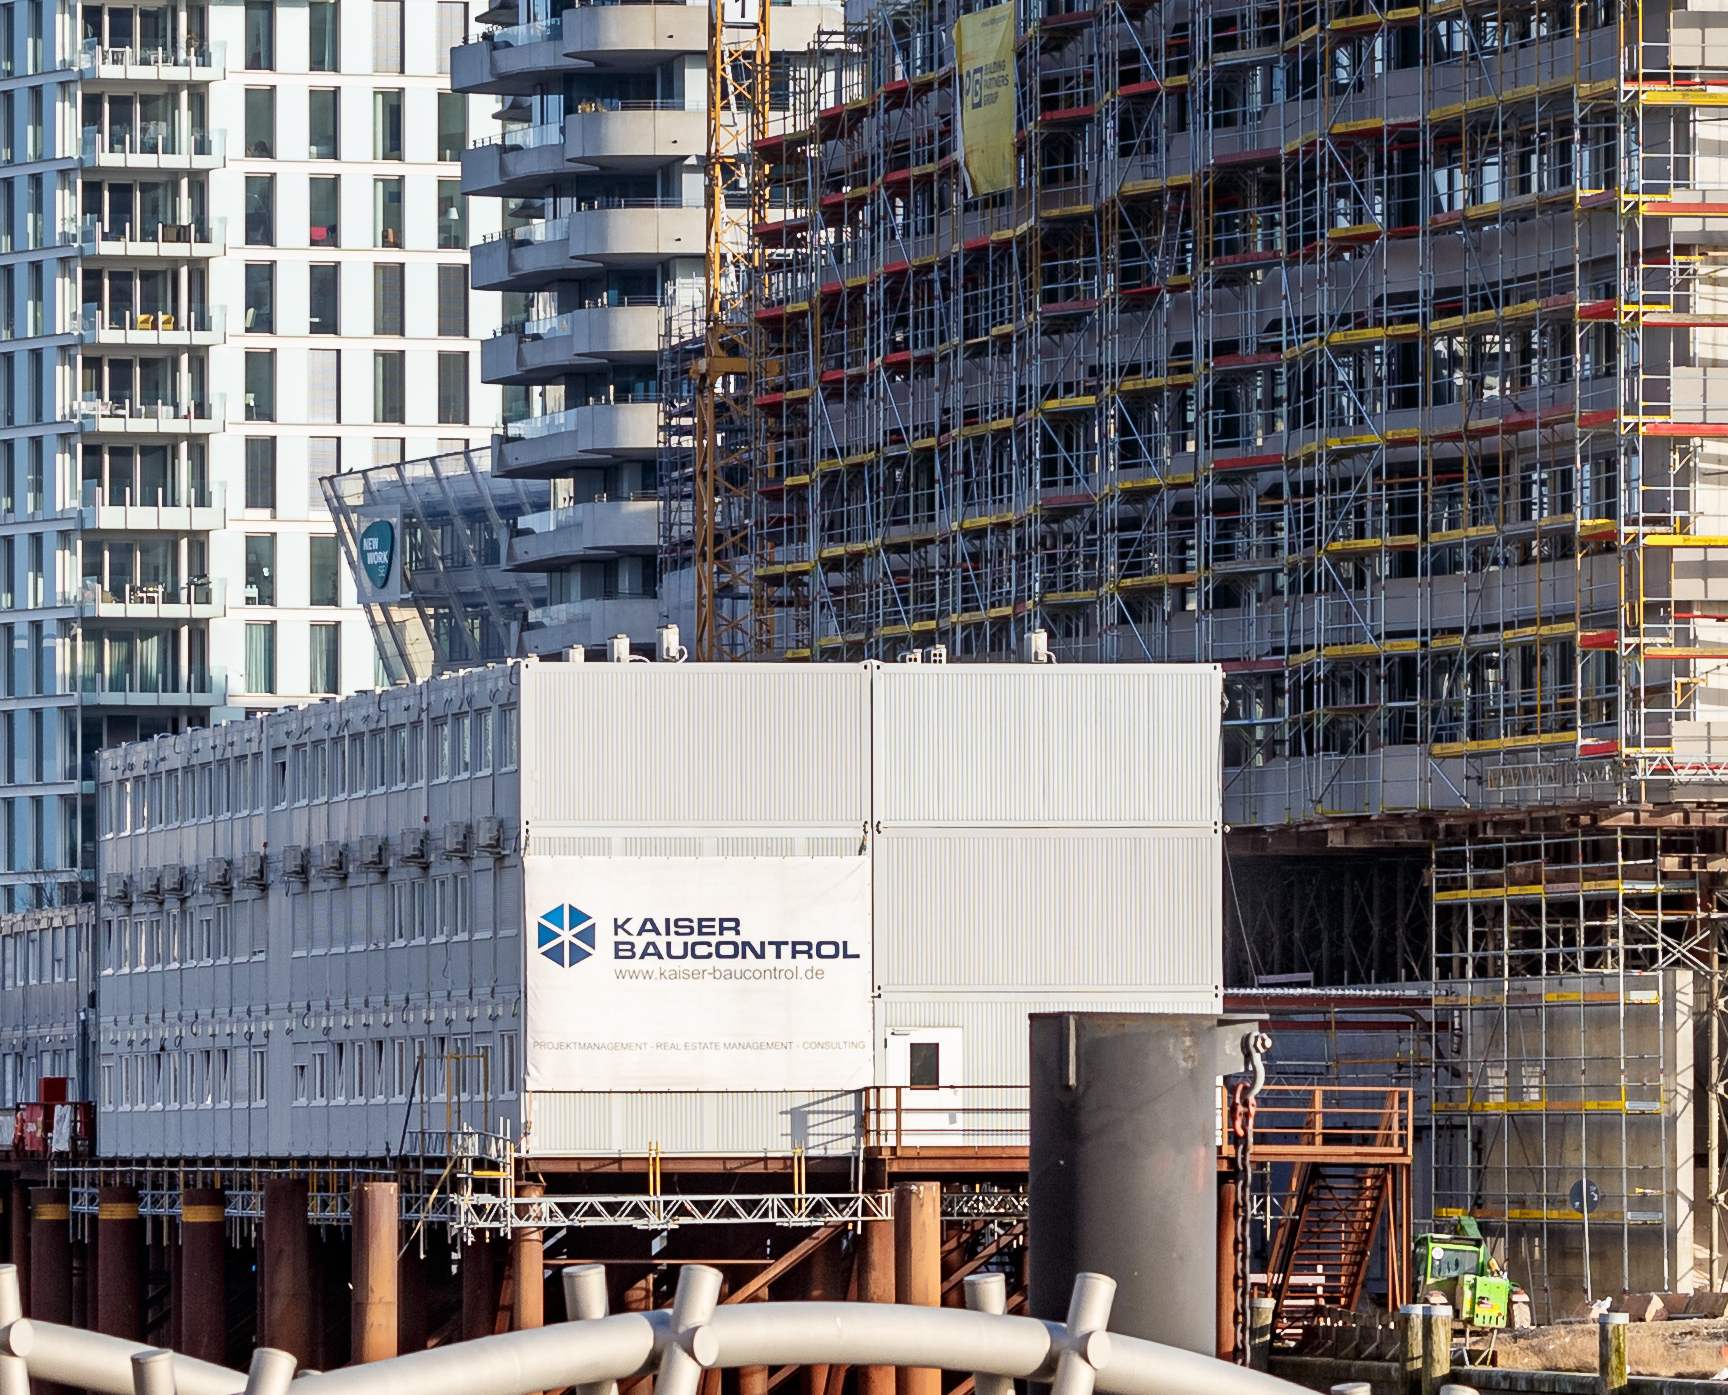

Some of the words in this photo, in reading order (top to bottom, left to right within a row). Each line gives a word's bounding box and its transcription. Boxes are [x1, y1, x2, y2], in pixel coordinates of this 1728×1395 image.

[363, 537, 379, 550] NEW
[367, 550, 389, 565] WORK
[378, 565, 386, 577] SE
[614, 917, 741, 936] KAISER
[614, 940, 860, 960] BAUCONTROL
[614, 965, 825, 982] www.kaiser-baucontrol.de
[533, 1041, 648, 1052] PROJEKTMANAGEMENT
[656, 1041, 682, 1052] REAL
[684, 1041, 721, 1052] ESTATE
[723, 1041, 794, 1052] MANAGEMENT
[802, 1040, 866, 1052] CONSULTING
